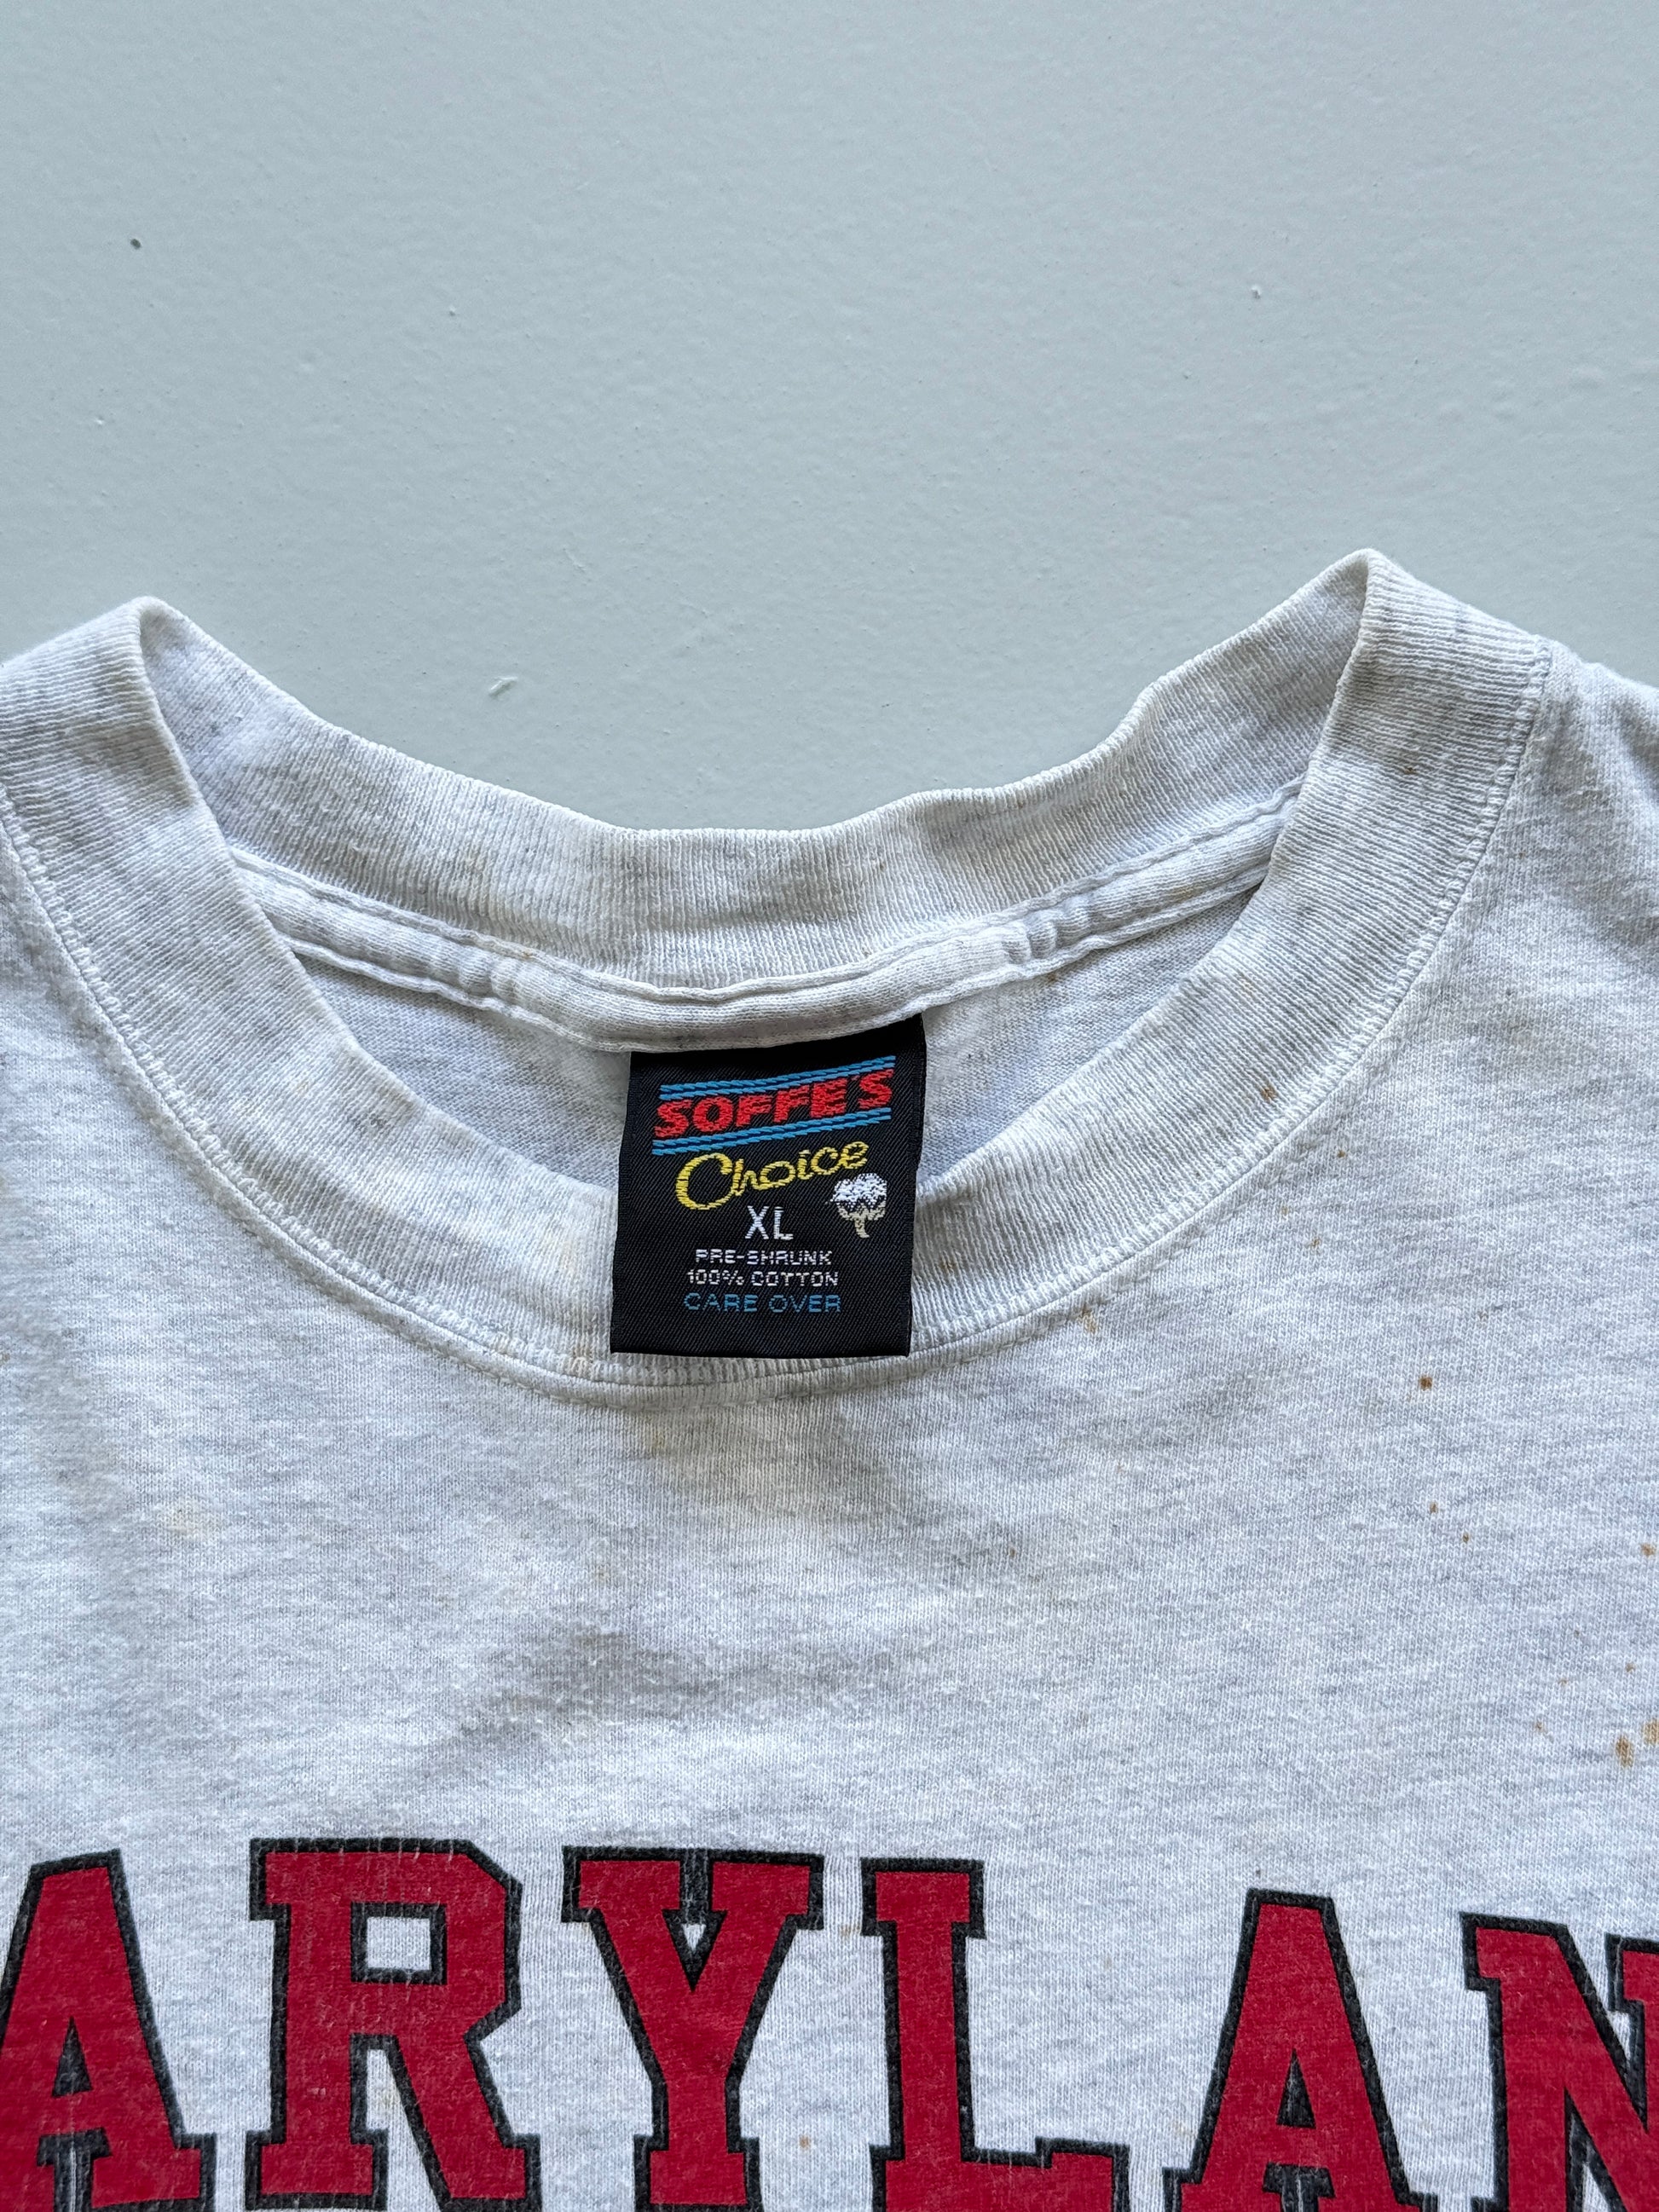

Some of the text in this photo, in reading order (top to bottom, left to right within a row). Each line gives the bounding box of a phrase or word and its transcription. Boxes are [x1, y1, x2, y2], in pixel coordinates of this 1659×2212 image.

[675, 1141, 868, 1210] Choice
[745, 1205, 794, 1240] XL
[696, 1248, 833, 1266] PRE-SHRUNK
[687, 1269, 839, 1287] 100% COTTON
[684, 1293, 841, 1314] CARE OVER
